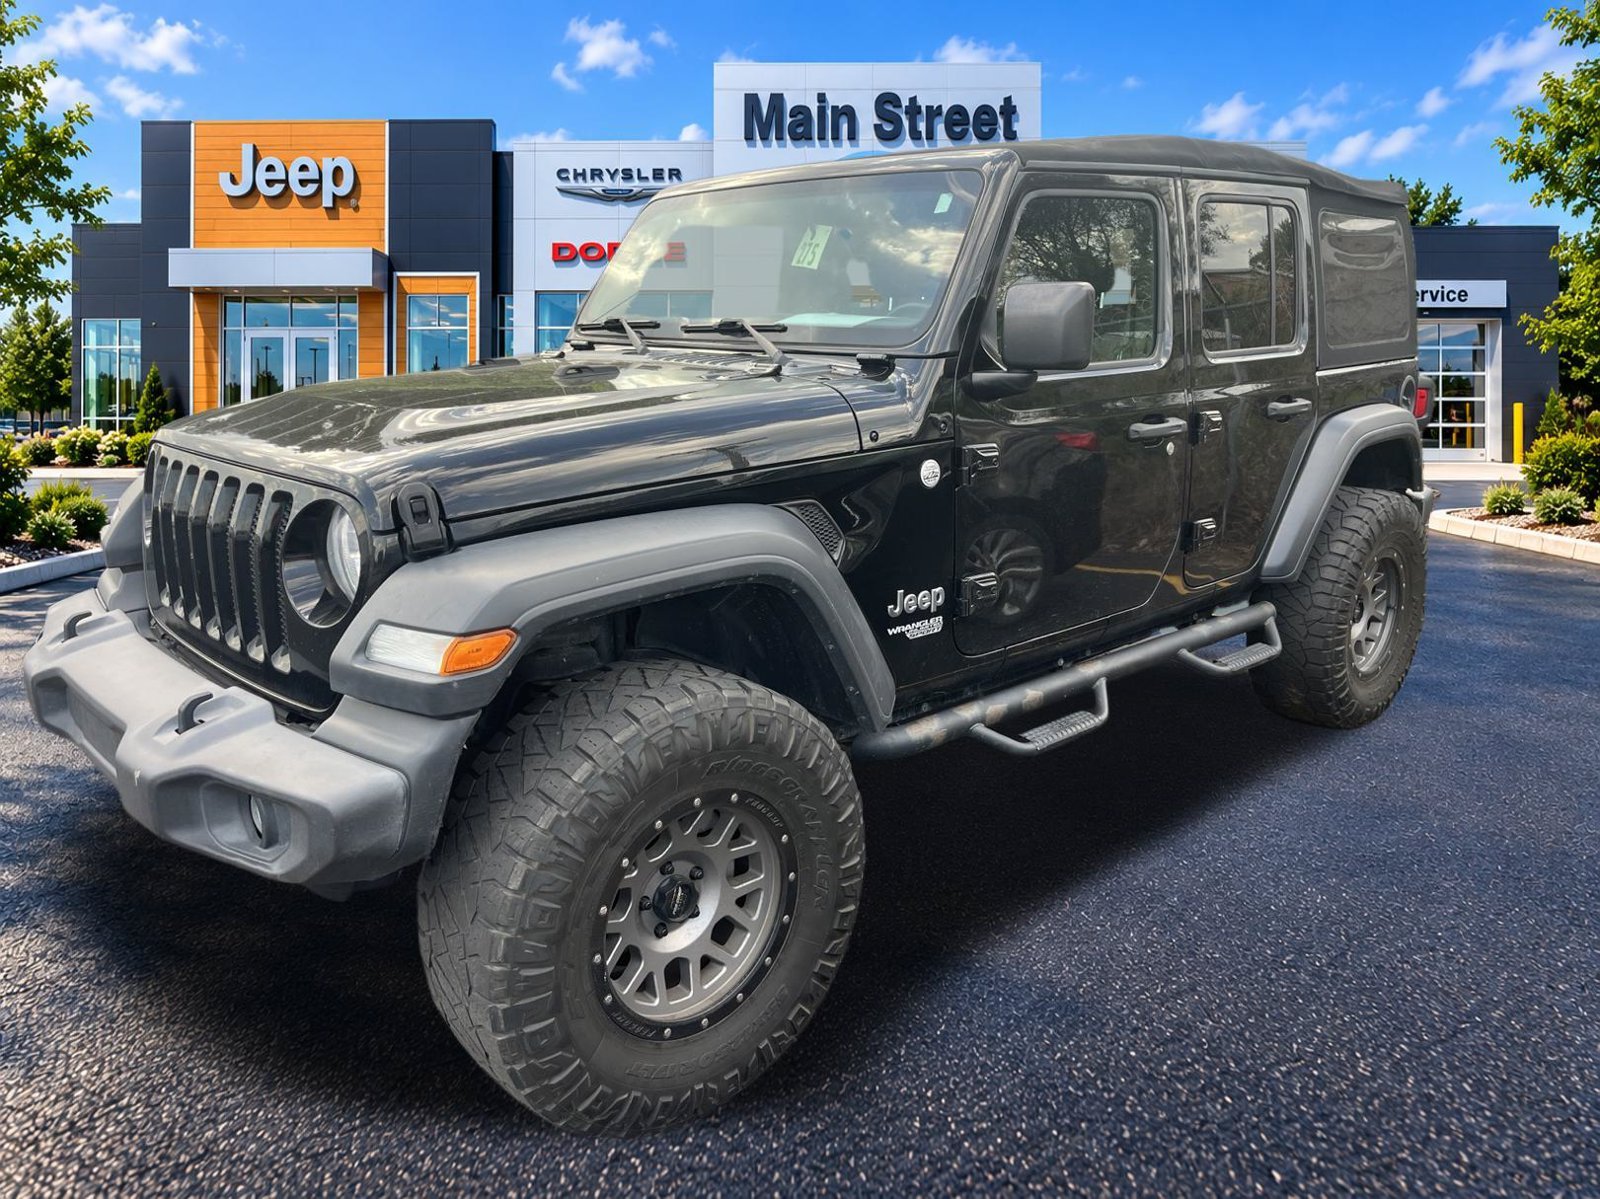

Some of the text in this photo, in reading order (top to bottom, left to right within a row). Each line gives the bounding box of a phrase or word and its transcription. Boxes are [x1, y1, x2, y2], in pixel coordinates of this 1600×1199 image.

[744, 91, 1017, 141] Main Street
[218, 143, 355, 208] Jeep
[556, 168, 682, 182] CHRYSLER
[551, 242, 688, 262] DOE
[1415, 285, 1469, 302] rvice
[887, 586, 945, 618] Jeep
[887, 616, 943, 636] WRANGLER
